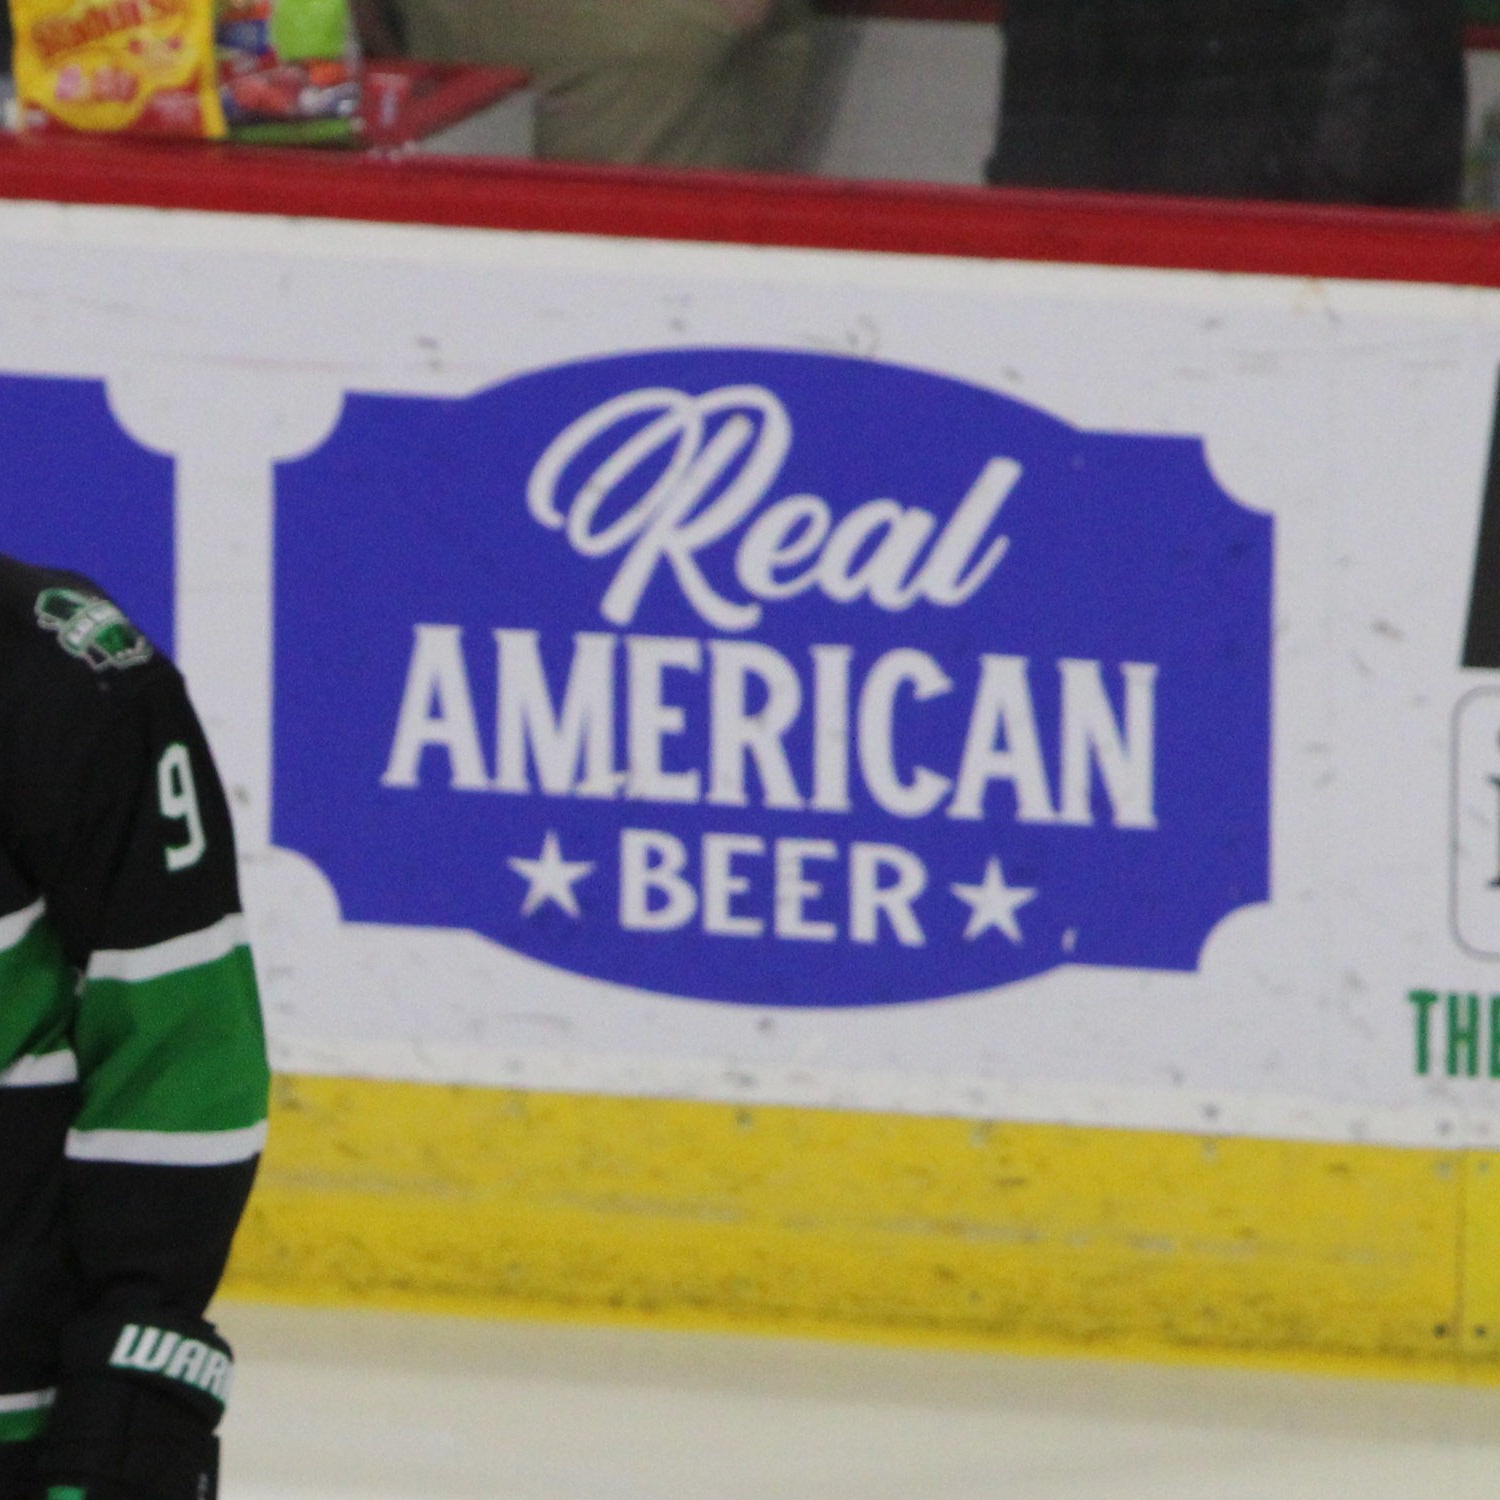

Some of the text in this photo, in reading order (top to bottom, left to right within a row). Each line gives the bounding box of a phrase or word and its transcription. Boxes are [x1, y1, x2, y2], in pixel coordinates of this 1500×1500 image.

[525, 382, 1023, 632] Real
[380, 623, 1158, 830] AMERICAN
[157, 742, 206, 872] 9
[618, 828, 928, 948] BEER
[108, 1323, 233, 1400] WAR
